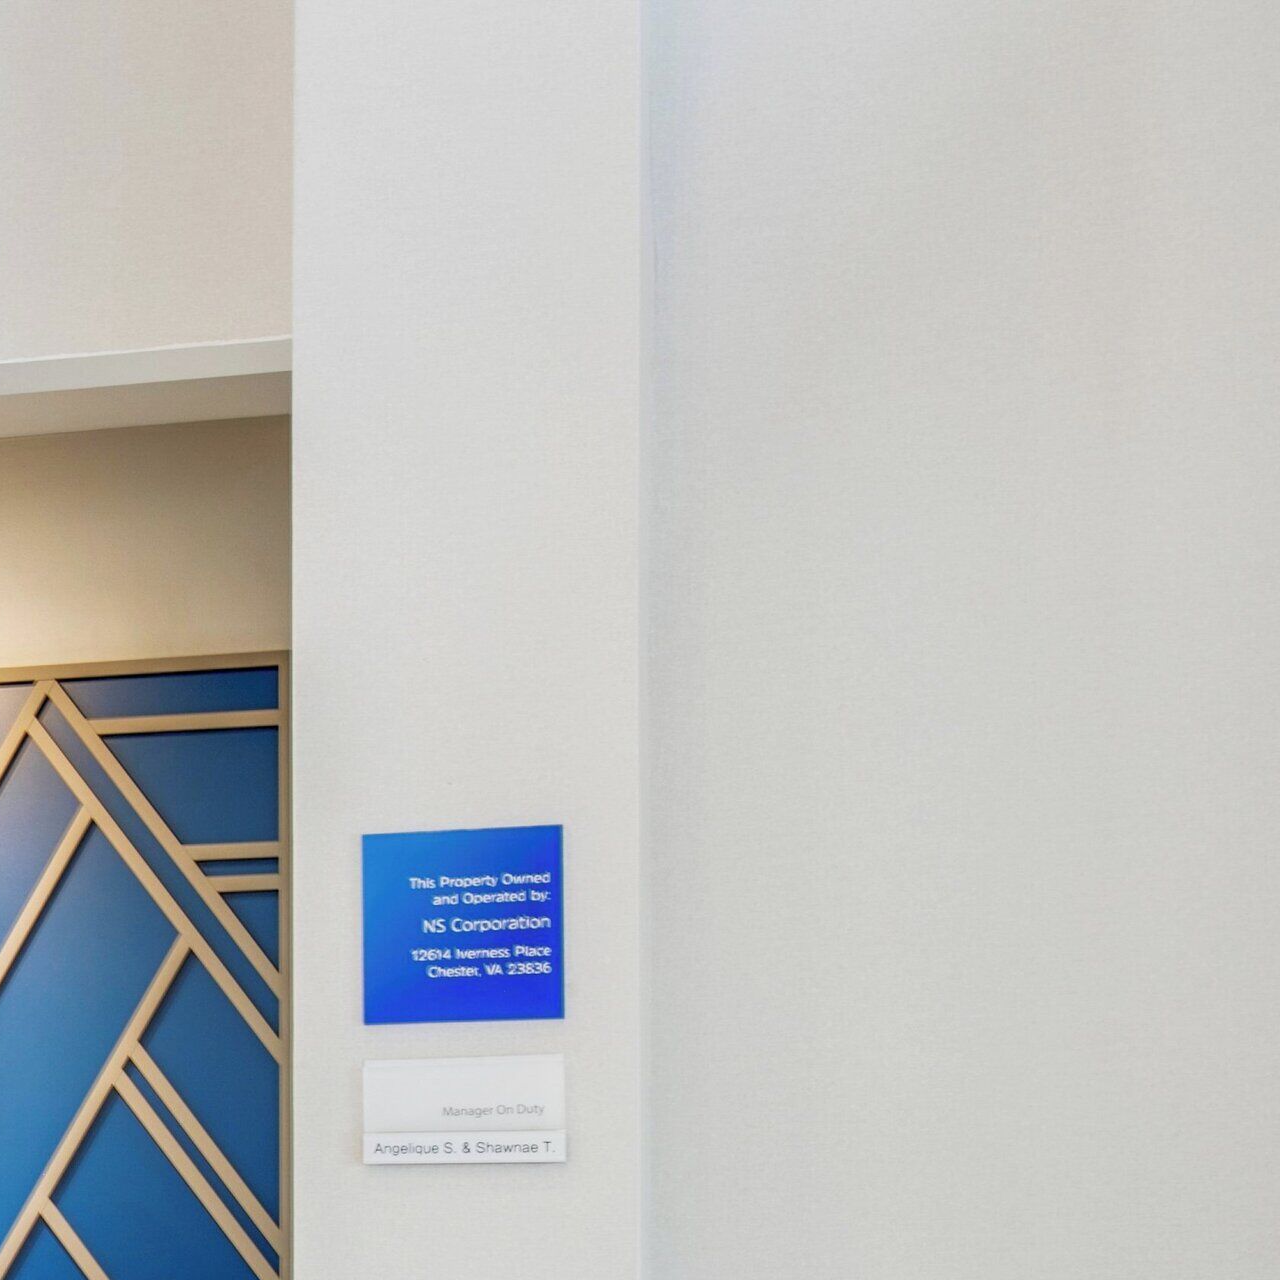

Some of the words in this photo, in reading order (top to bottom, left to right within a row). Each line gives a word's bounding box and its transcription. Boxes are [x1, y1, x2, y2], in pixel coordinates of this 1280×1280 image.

[409, 877, 436, 889] This
[440, 875, 498, 888] Property
[502, 872, 551, 886] Owned
[432, 893, 459, 906] and
[462, 891, 526, 905] Operated
[530, 890, 551, 902] by:
[423, 919, 446, 934] NS
[451, 916, 552, 933] Corporation
[411, 949, 452, 962] 12614
[514, 944, 552, 958] Place
[427, 965, 482, 978] Chester,
[484, 963, 504, 976] VA
[507, 962, 552, 975] 23836
[442, 1106, 494, 1118] Manager
[496, 1105, 514, 1116] On
[516, 1104, 545, 1117] Duty
[374, 1142, 439, 1156] Angelique
[443, 1142, 457, 1154] S.
[462, 1142, 472, 1153] &
[476, 1141, 539, 1154] Shawnae
[543, 1141, 556, 1153] T.
